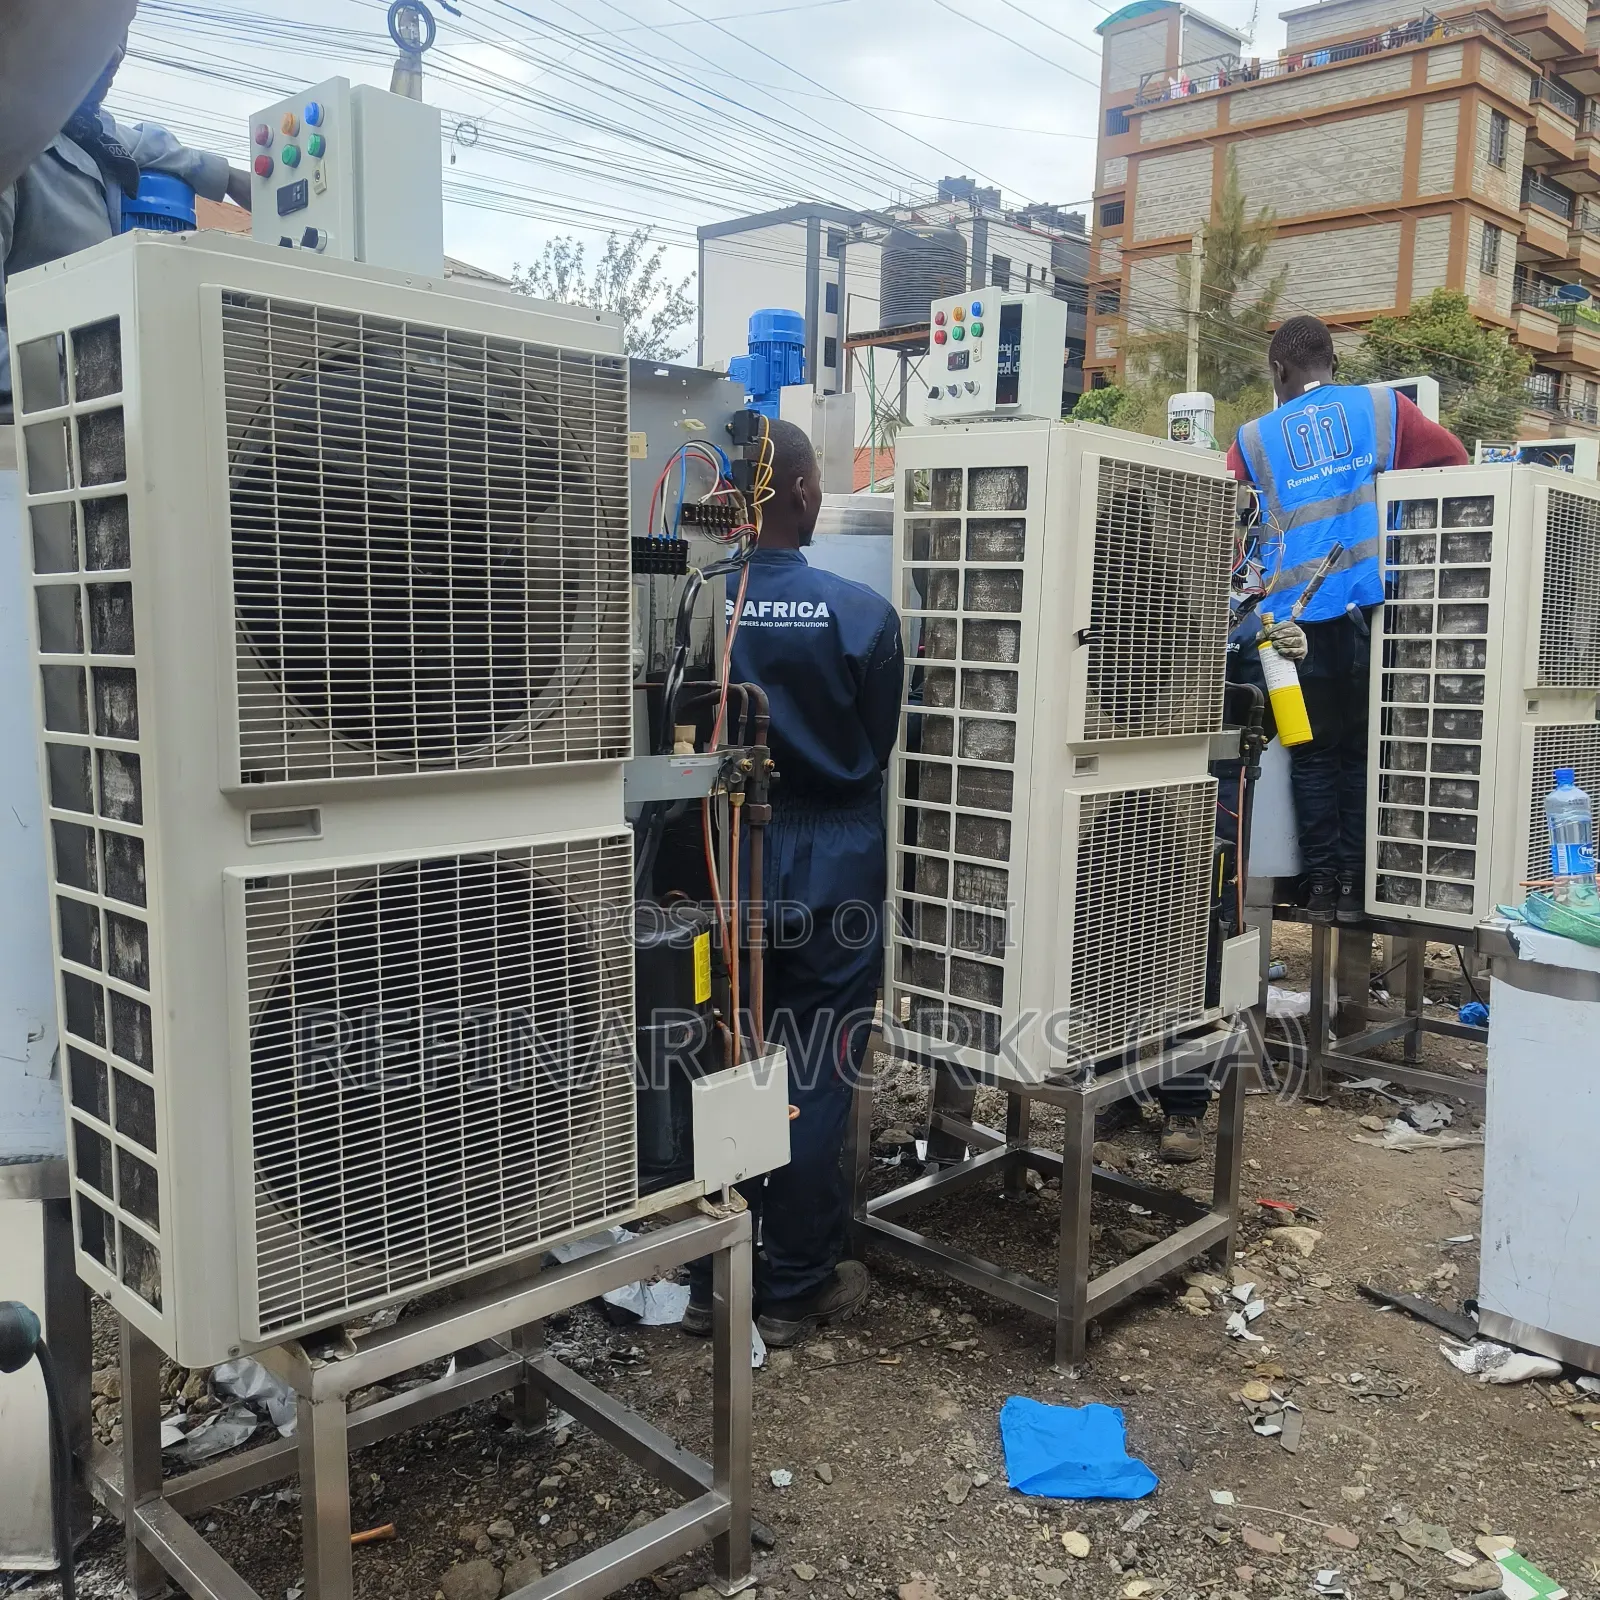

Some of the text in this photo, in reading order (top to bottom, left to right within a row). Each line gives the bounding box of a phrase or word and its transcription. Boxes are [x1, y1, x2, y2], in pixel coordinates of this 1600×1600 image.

[1321, 465, 1352, 477] WORKS
[1352, 453, 1373, 470] (EA)
[742, 600, 830, 618] AFRICA
